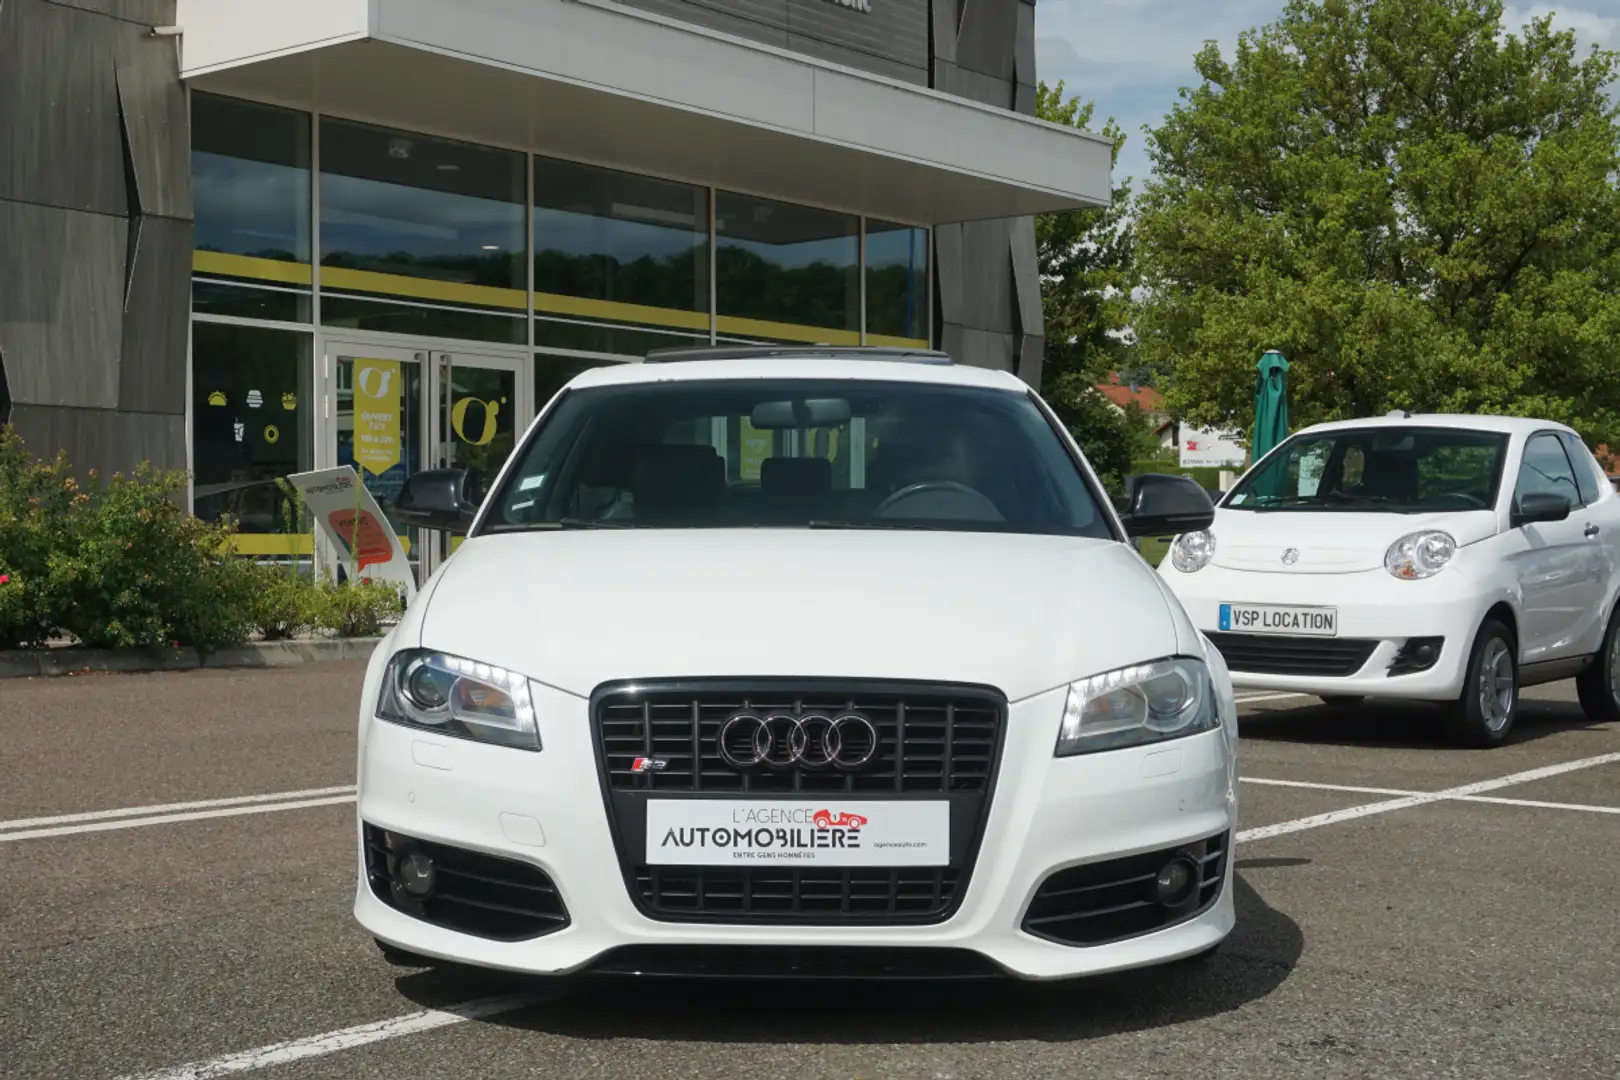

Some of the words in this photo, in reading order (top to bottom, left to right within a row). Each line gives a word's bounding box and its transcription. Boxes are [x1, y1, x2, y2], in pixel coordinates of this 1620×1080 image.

[1233, 610, 1259, 627] VSP
[1263, 611, 1333, 630] LOCATION
[732, 807, 814, 824] L'AGENCE
[732, 851, 756, 859] ENTRE
[757, 851, 776, 859] GENS
